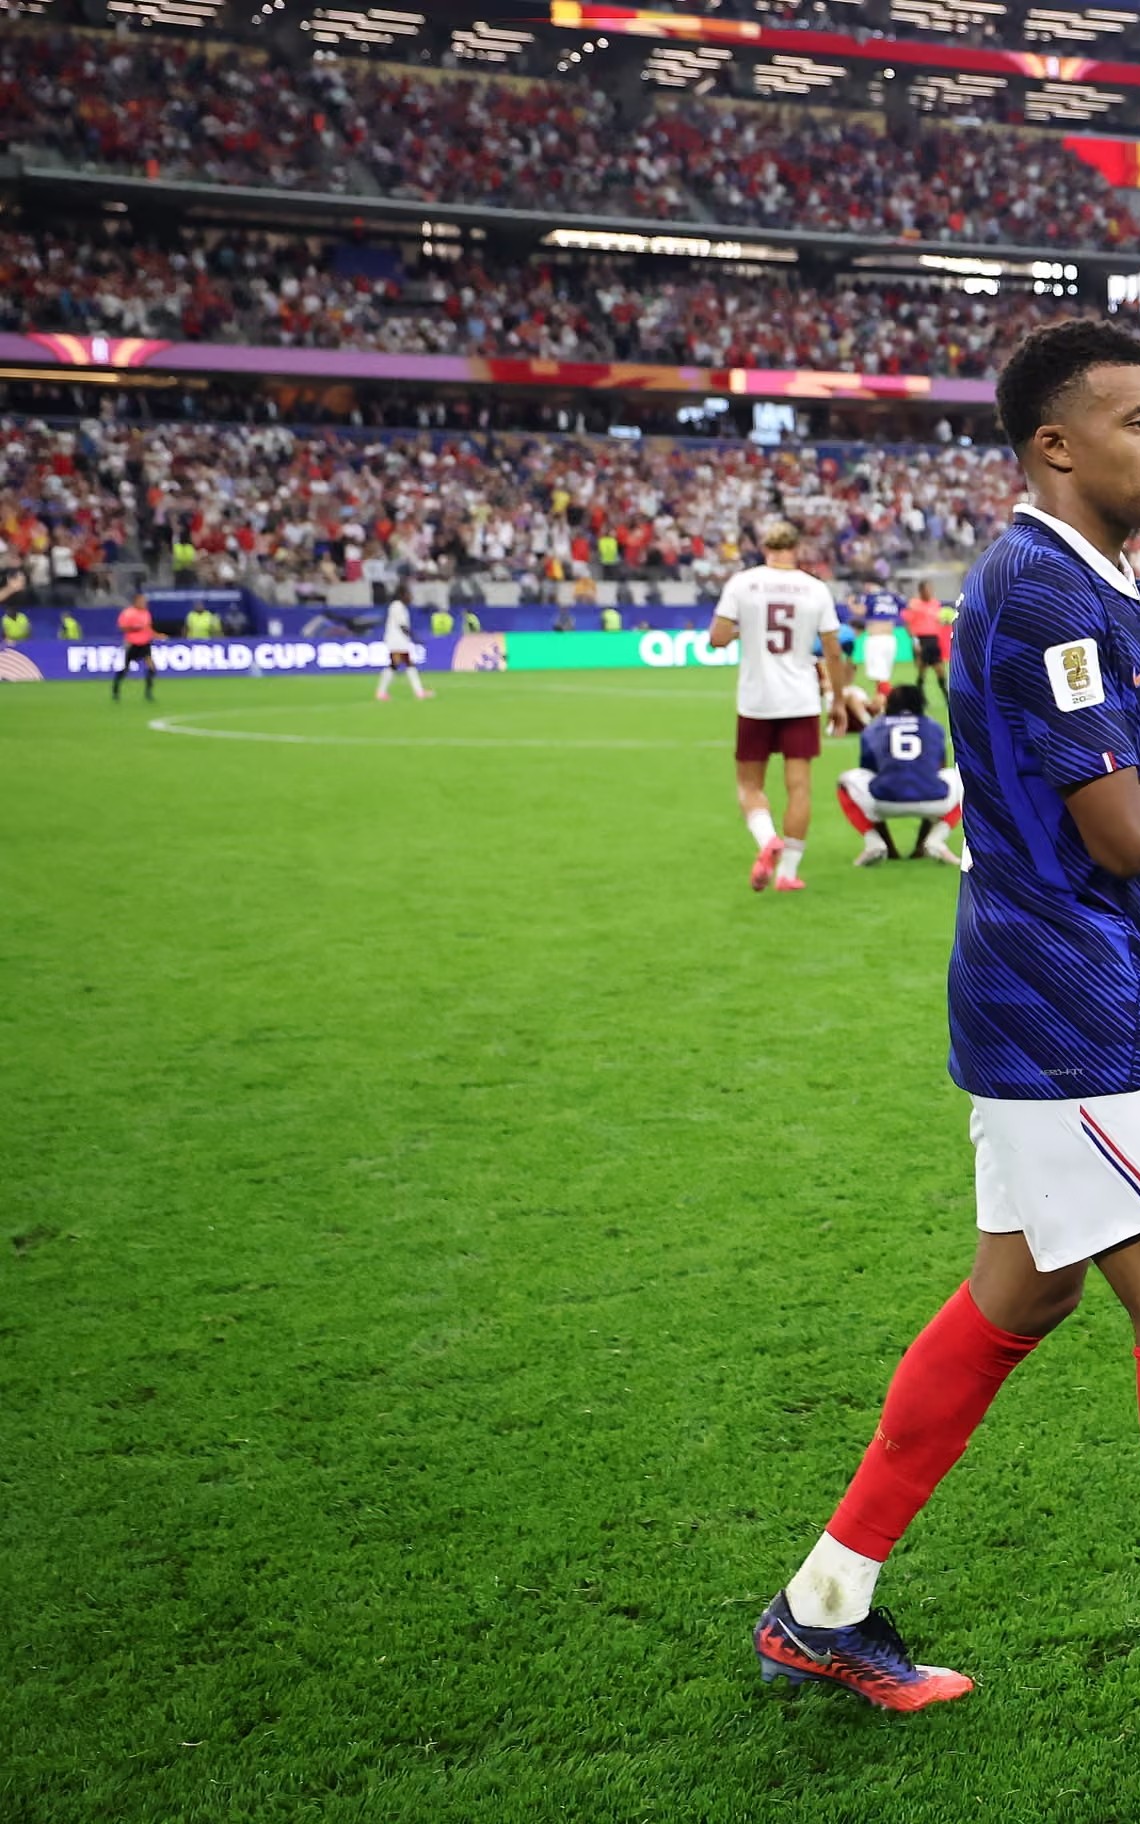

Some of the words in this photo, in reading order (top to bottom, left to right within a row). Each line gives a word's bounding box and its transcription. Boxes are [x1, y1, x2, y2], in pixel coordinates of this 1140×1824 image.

[766, 602, 795, 654] 5
[150, 644, 252, 671] WORLD
[254, 643, 316, 669] CUP
[317, 642, 416, 668] 202
[889, 723, 922, 761] 6
